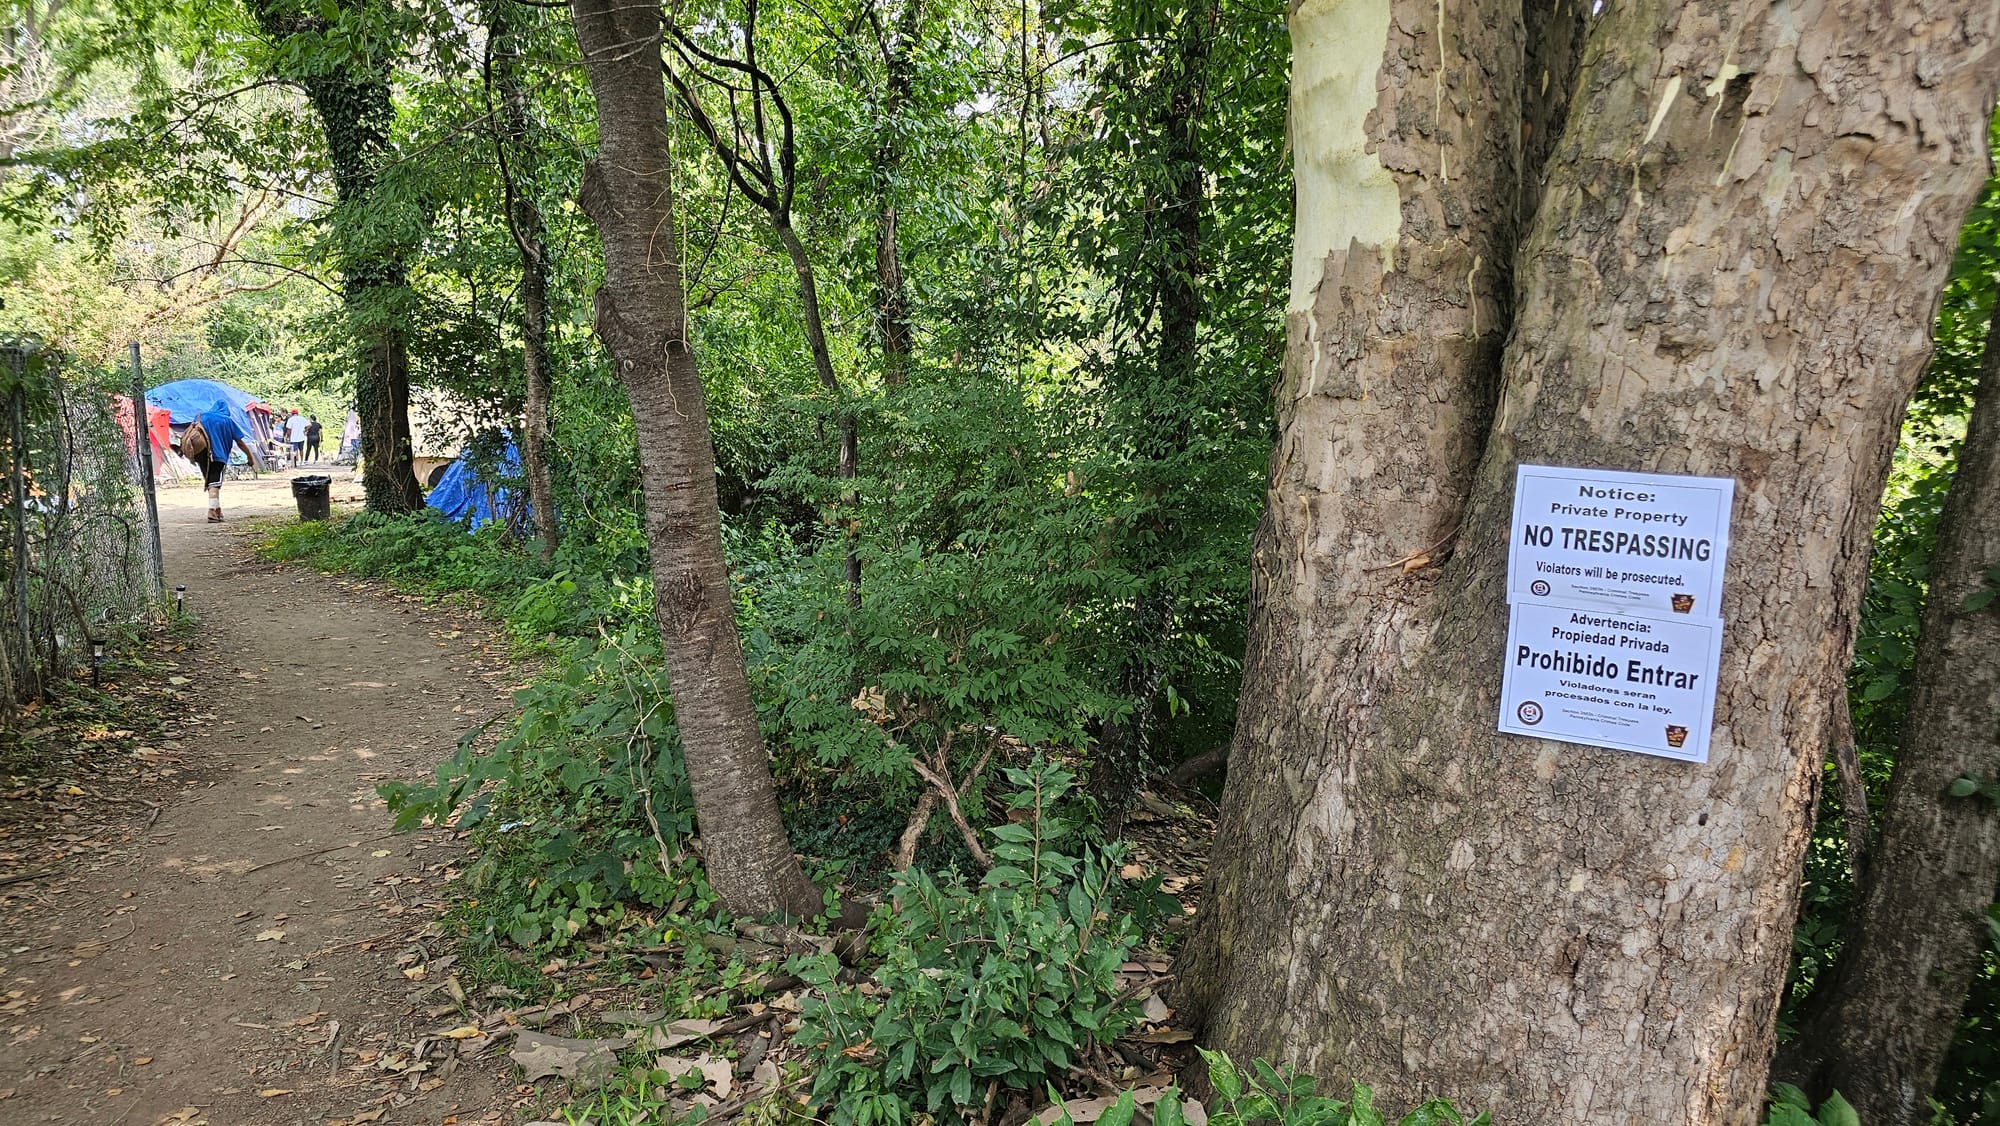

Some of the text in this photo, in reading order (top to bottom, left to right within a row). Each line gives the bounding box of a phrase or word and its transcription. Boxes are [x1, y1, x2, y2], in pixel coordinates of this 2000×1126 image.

[1578, 485, 1656, 502] Notice:
[1551, 502, 1688, 527] Private Property
[1524, 524, 1711, 562] NO TRESPASSING
[1536, 561, 1685, 587] Violators will be prosecuted.
[1570, 612, 1651, 634] Advertencia:
[1551, 627, 1670, 653] Propiedad Privada
[1516, 645, 1699, 690] Prohibido Entrar
[1544, 689, 1673, 715] procesados con la ley.
[1559, 679, 1657, 700] Violadores seran
